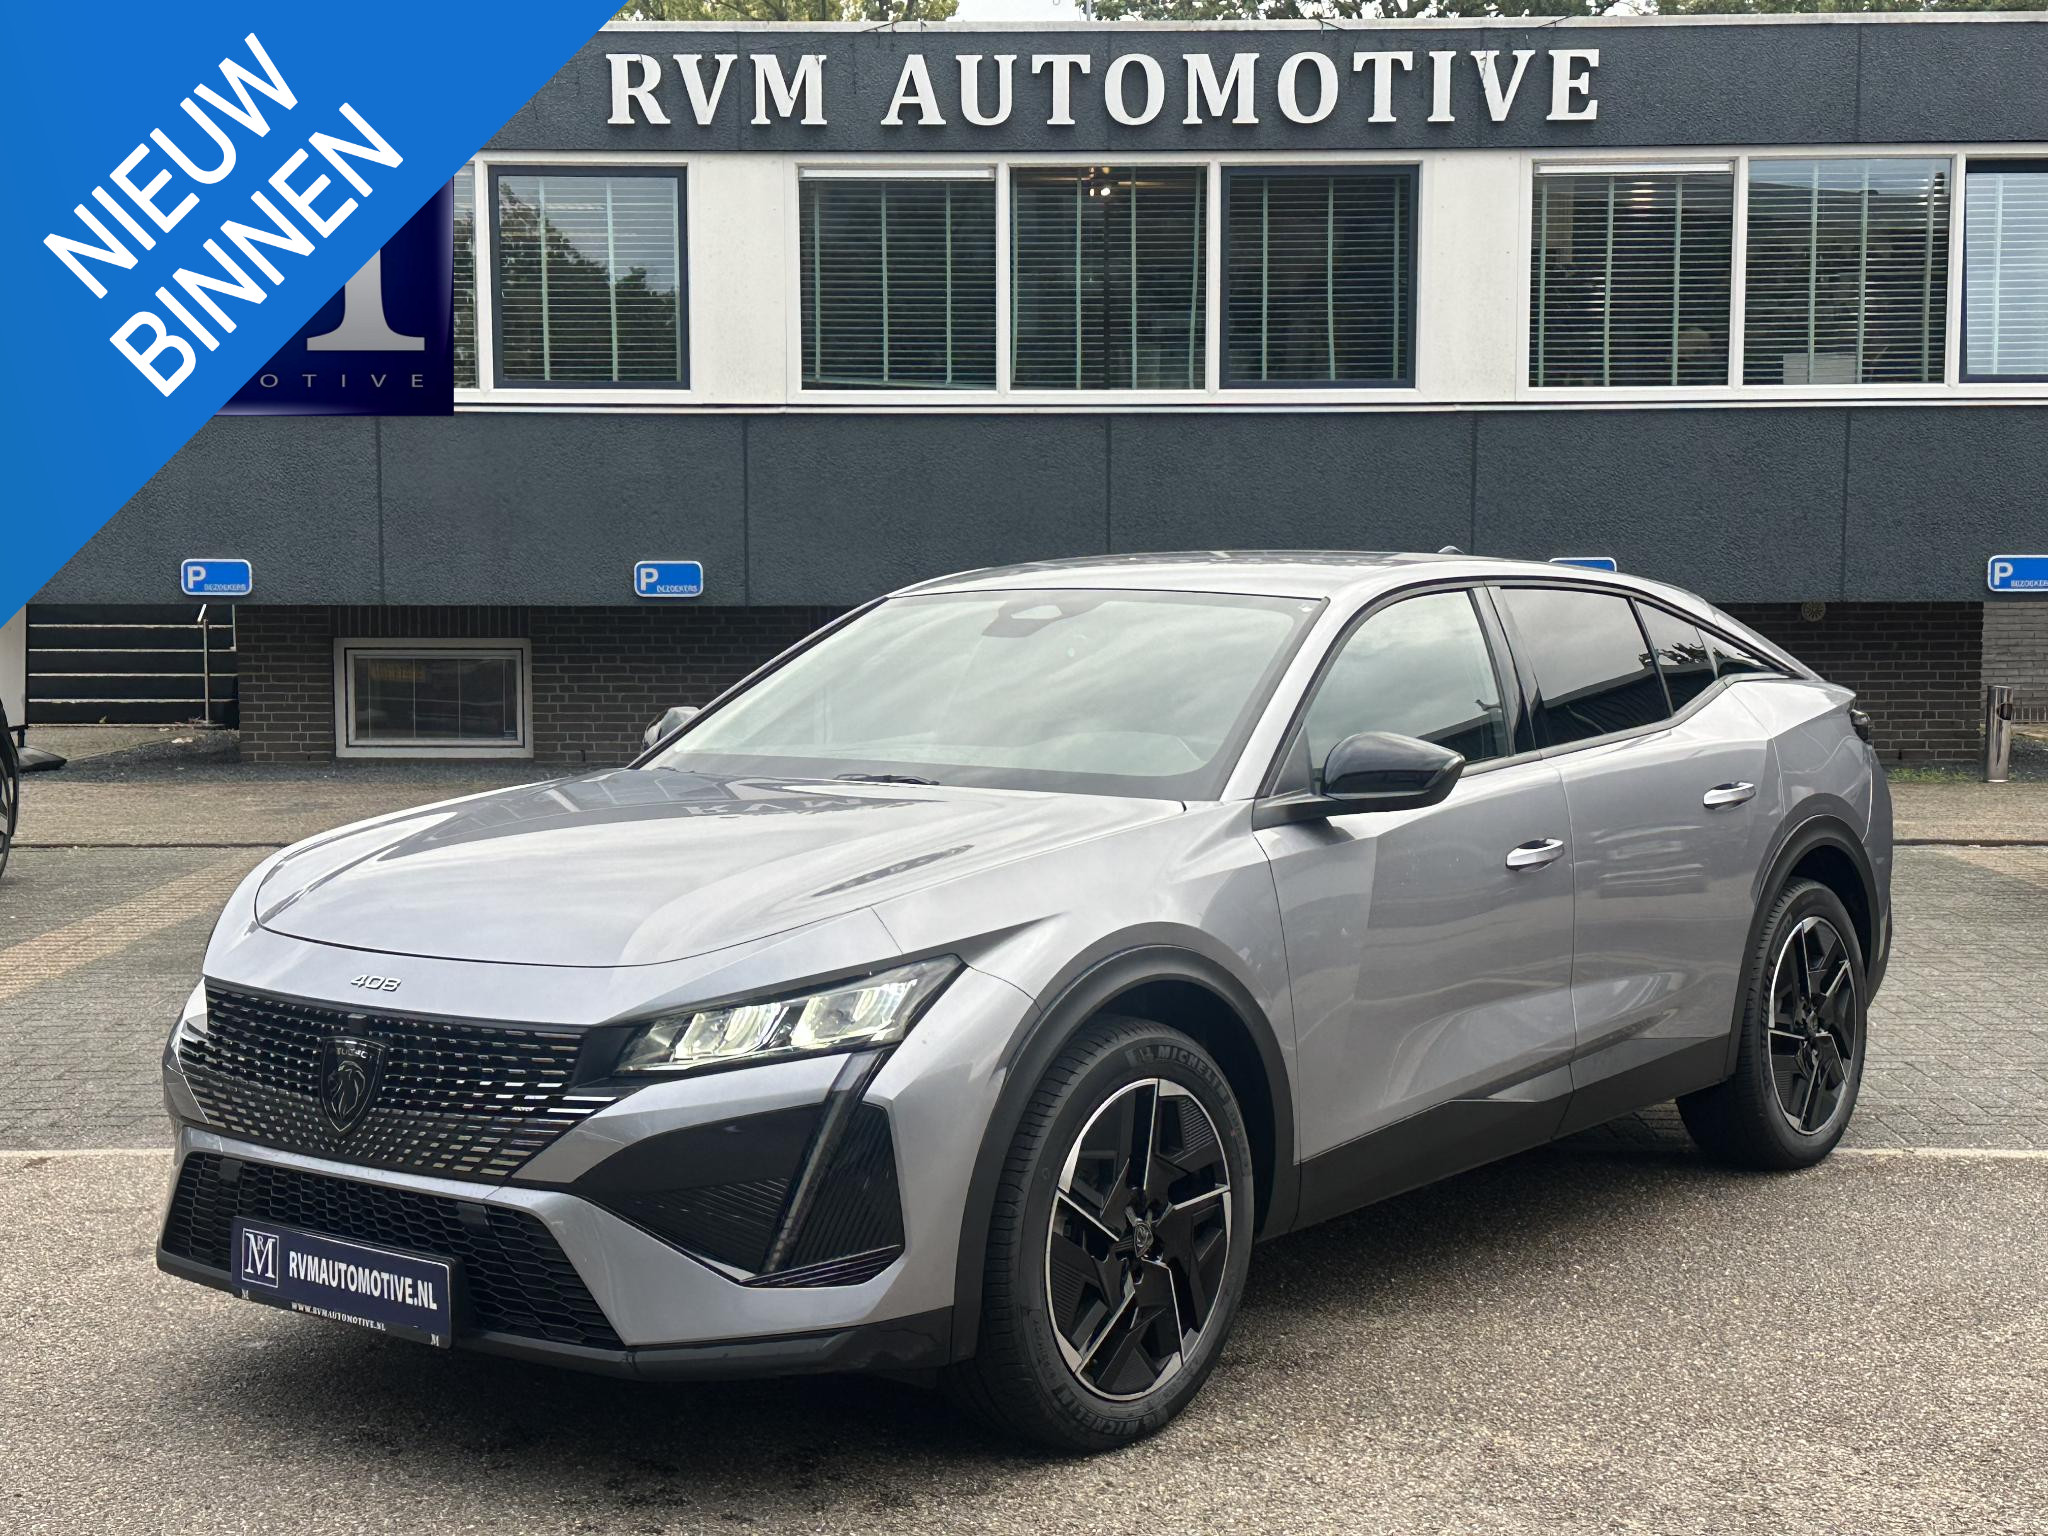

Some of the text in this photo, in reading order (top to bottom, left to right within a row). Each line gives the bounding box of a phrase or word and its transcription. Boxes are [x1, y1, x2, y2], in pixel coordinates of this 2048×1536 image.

[605, 48, 1600, 126] RVM AUTOMOTIVE
[187, 565, 206, 589] P
[640, 567, 658, 591] P
[1994, 562, 2013, 586] P
[351, 974, 401, 992] 408
[288, 1251, 438, 1310] RVMAUTOMOTIVE.NL
